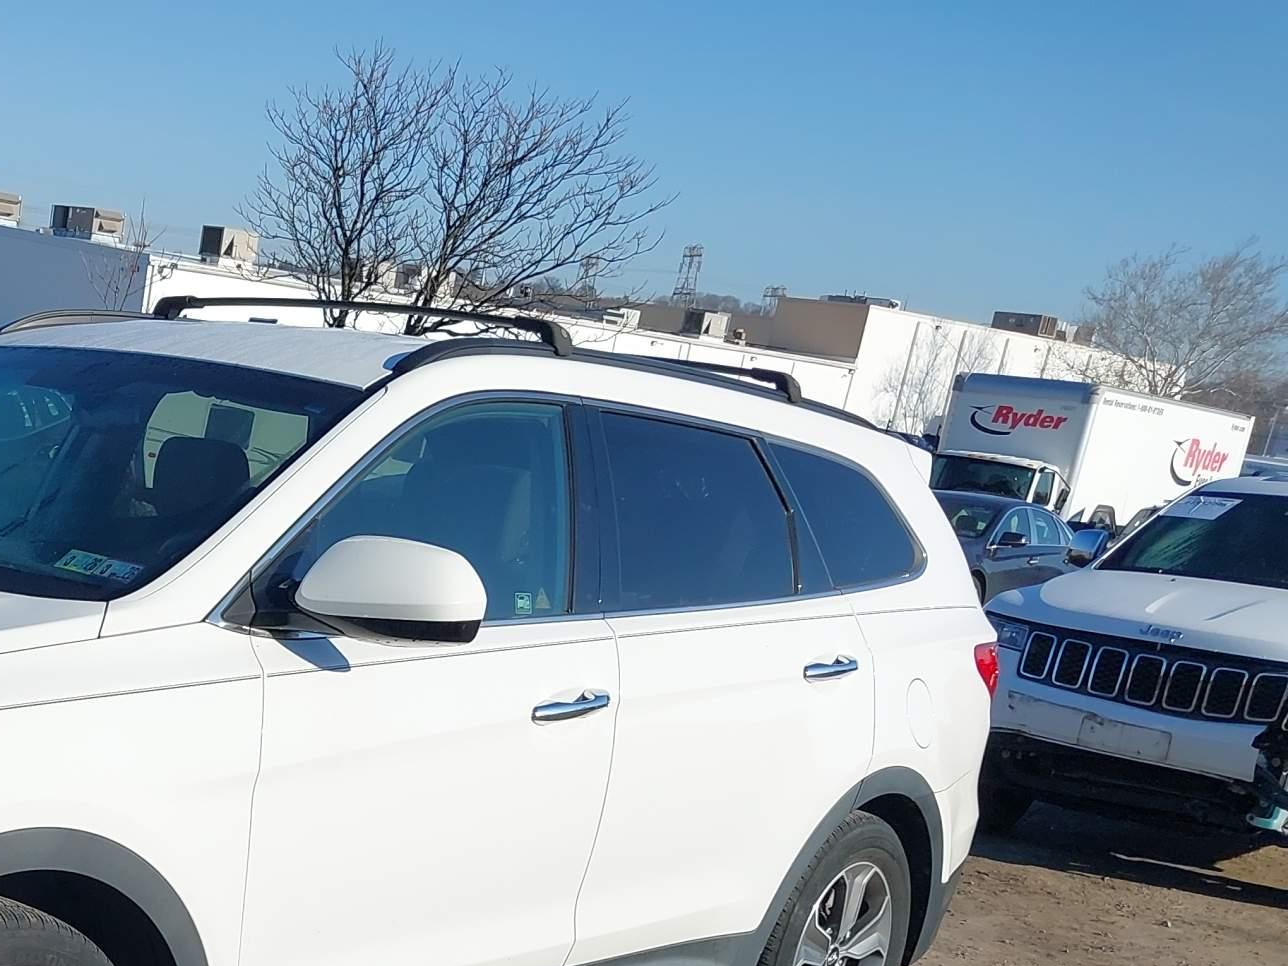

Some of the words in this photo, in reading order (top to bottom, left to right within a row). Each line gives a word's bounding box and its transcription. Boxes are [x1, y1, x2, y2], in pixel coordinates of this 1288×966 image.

[992, 405, 1068, 429] Ryder
[1183, 439, 1229, 476] Ryder
[1139, 624, 1184, 643] Jeep
